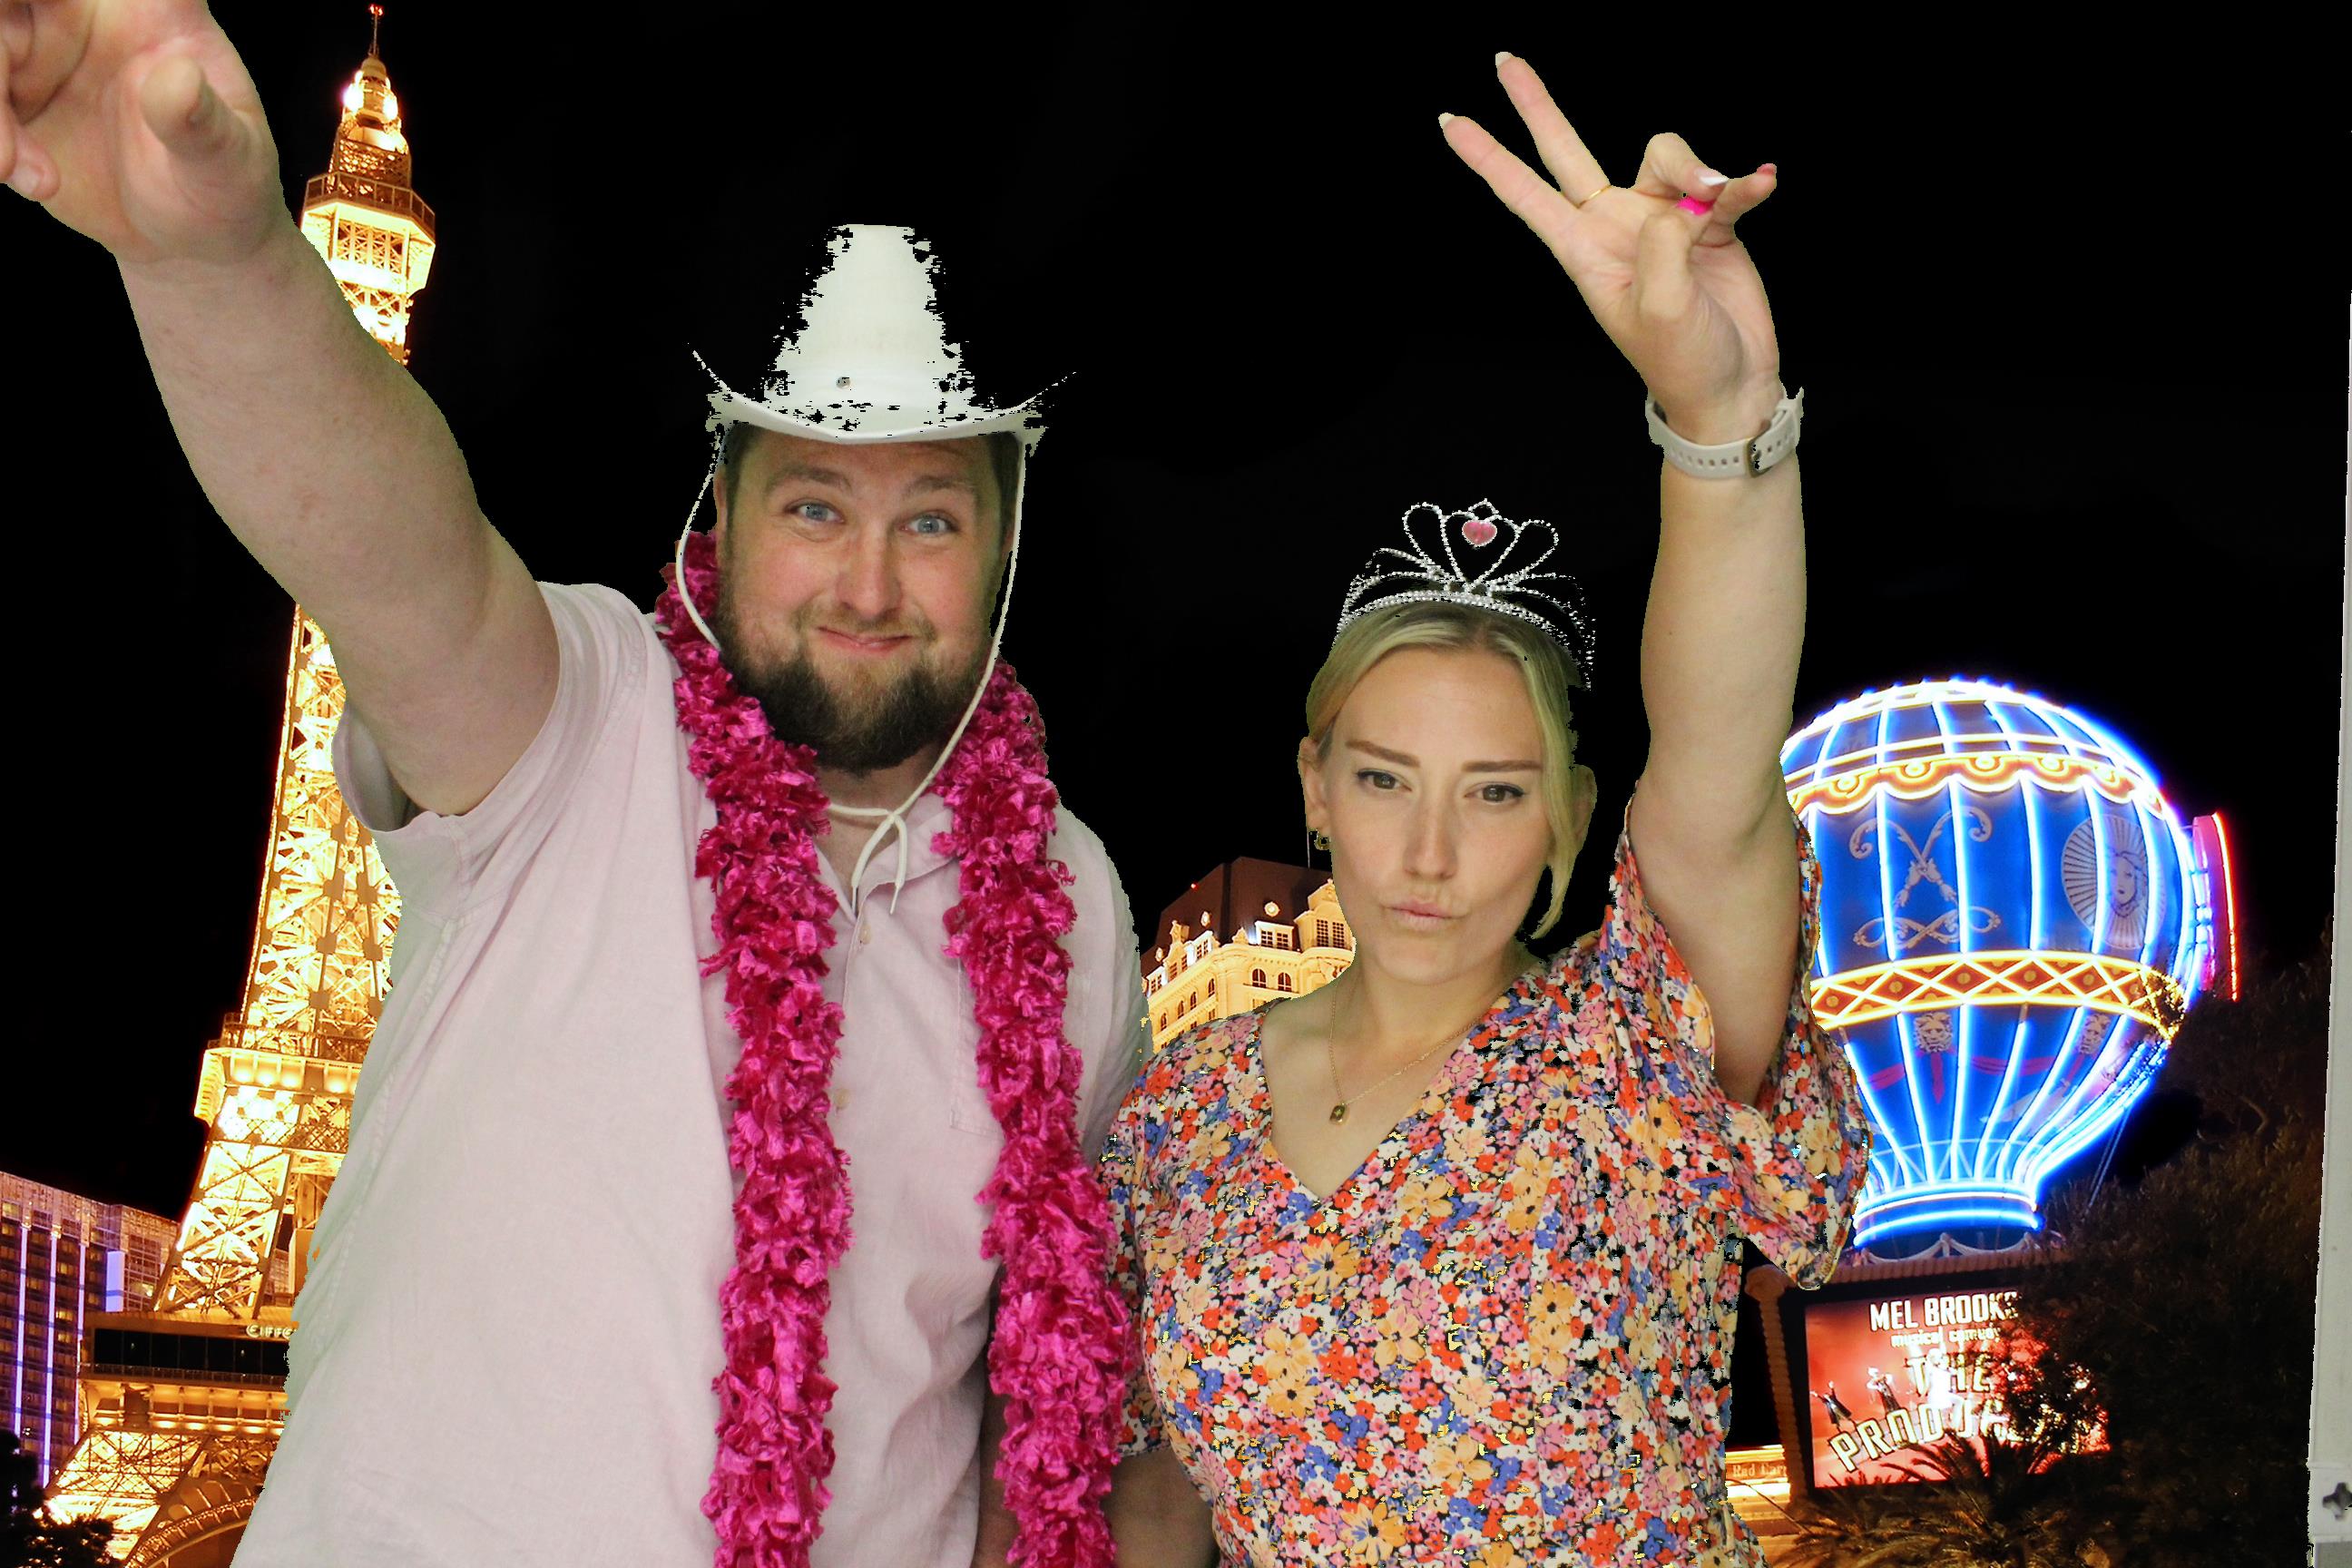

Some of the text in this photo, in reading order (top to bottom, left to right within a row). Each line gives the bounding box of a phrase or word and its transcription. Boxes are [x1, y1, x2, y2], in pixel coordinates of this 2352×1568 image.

[1870, 1300, 1919, 1331] MEL
[246, 1324, 292, 1340] EIFFE
[1906, 1353, 1992, 1396] THE
